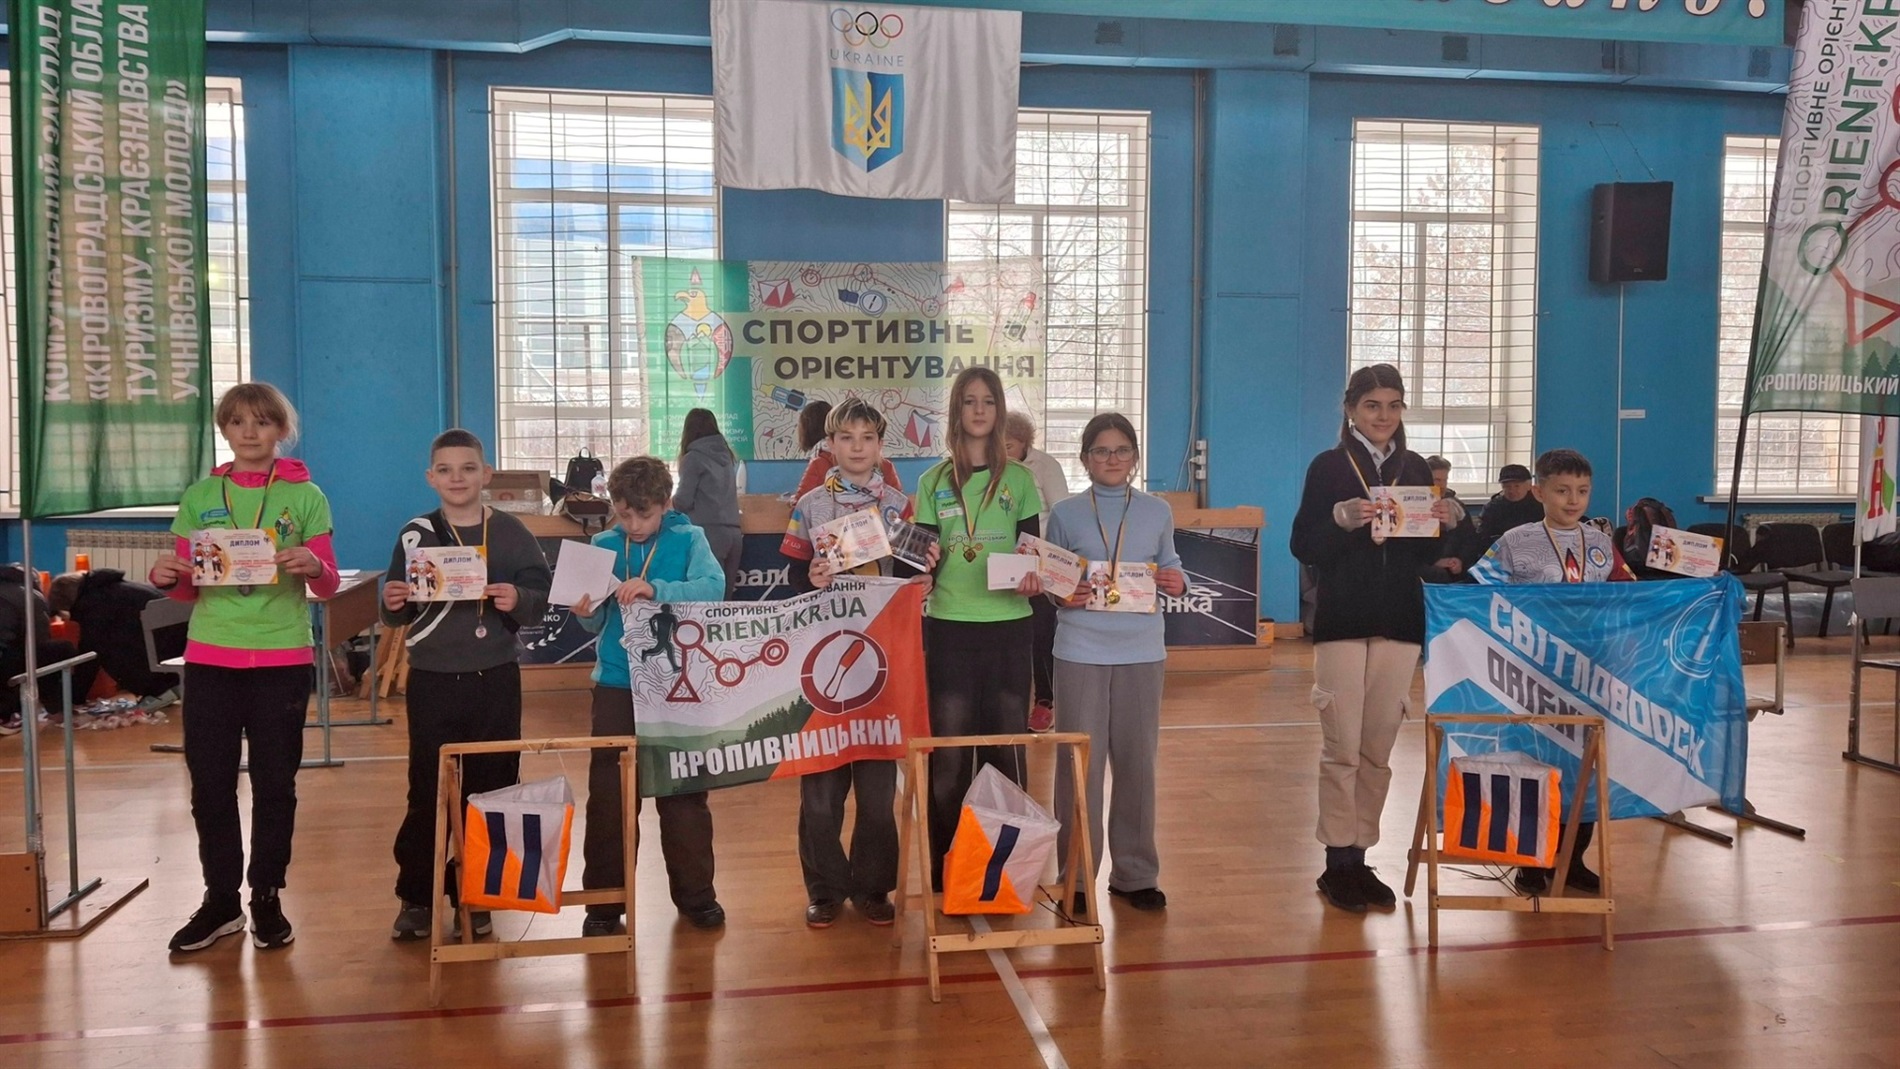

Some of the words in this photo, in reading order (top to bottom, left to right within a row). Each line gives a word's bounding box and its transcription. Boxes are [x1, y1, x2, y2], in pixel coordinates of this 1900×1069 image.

[829, 48, 904, 67] UKRAINE
[117, 4, 152, 239] КРАЄЗНАВСТВА
[163, 78, 193, 219] МОЛОДІ»
[1791, 77, 1831, 215] СПОРТИВНЕ
[66, 90, 111, 401] «КІРОВОГРАДСЬКИЙ
[161, 222, 200, 400] УЧНІВСЬКОЇ
[742, 319, 975, 345] СПОРТИВНЕ
[773, 354, 1035, 380] ОРІЄНТУВАННЯ
[443, 556, 472, 564] ДИПЛОМ
[705, 606, 778, 619] СПОРТИВНЕ
[669, 714, 902, 780] КРОПИВНИЦЬКИЙ
